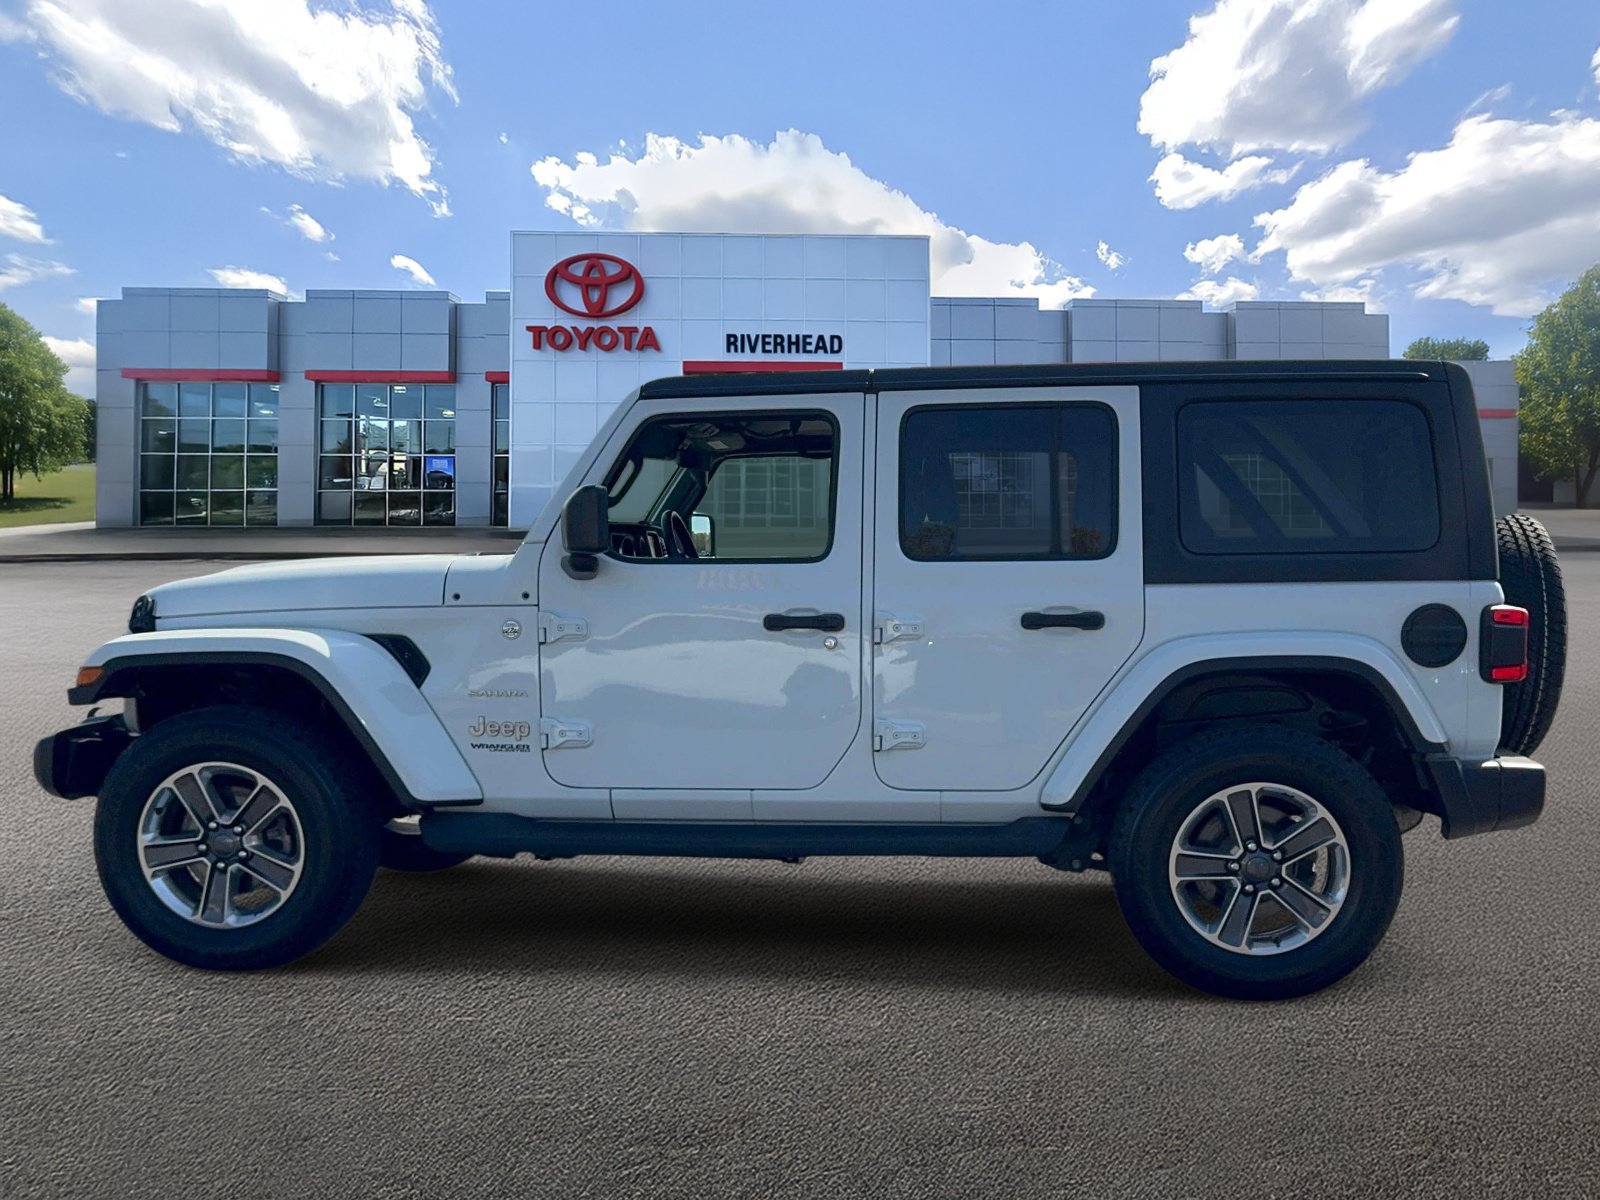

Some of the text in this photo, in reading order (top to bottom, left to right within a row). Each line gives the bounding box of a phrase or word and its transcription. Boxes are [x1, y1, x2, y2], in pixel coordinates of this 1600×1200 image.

[526, 325, 660, 351] TOYOTA
[726, 333, 843, 354] RIVERHEAD
[468, 715, 531, 741] Jeep
